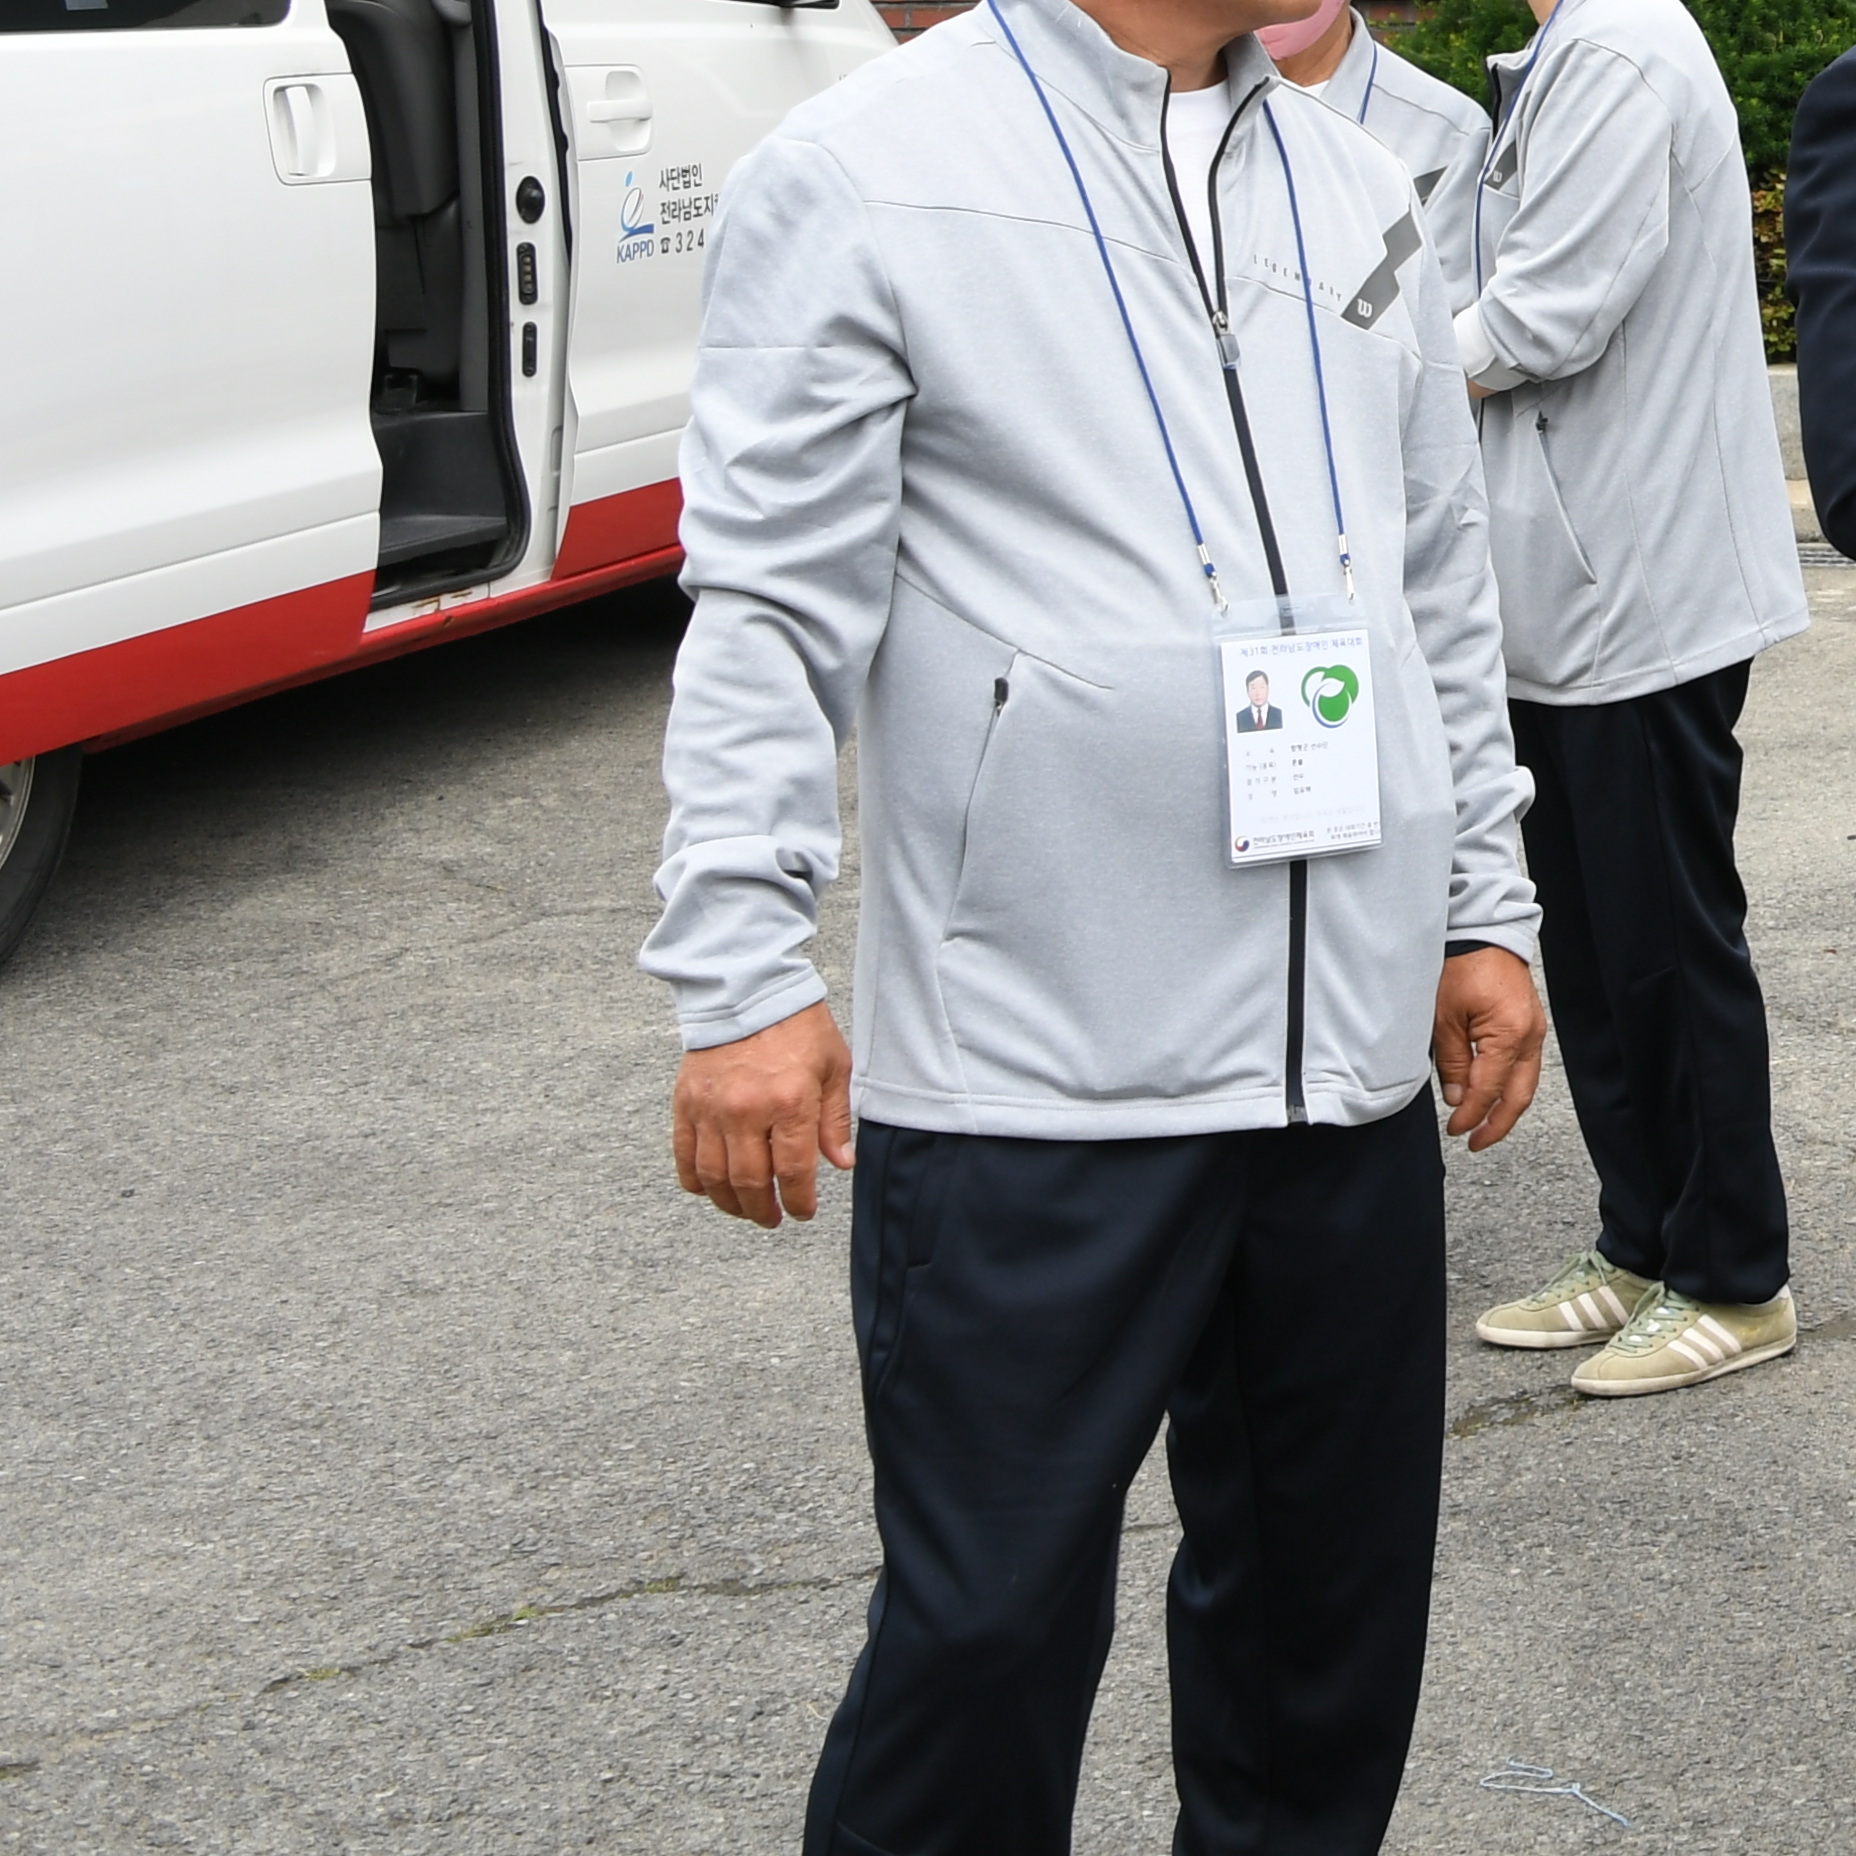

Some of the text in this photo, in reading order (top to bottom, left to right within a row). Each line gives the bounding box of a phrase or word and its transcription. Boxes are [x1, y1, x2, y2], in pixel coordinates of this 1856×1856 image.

[659, 163, 703, 192] 사단법인
[616, 239, 655, 264] KAPPD
[1254, 254, 1342, 302] LEGENARY
